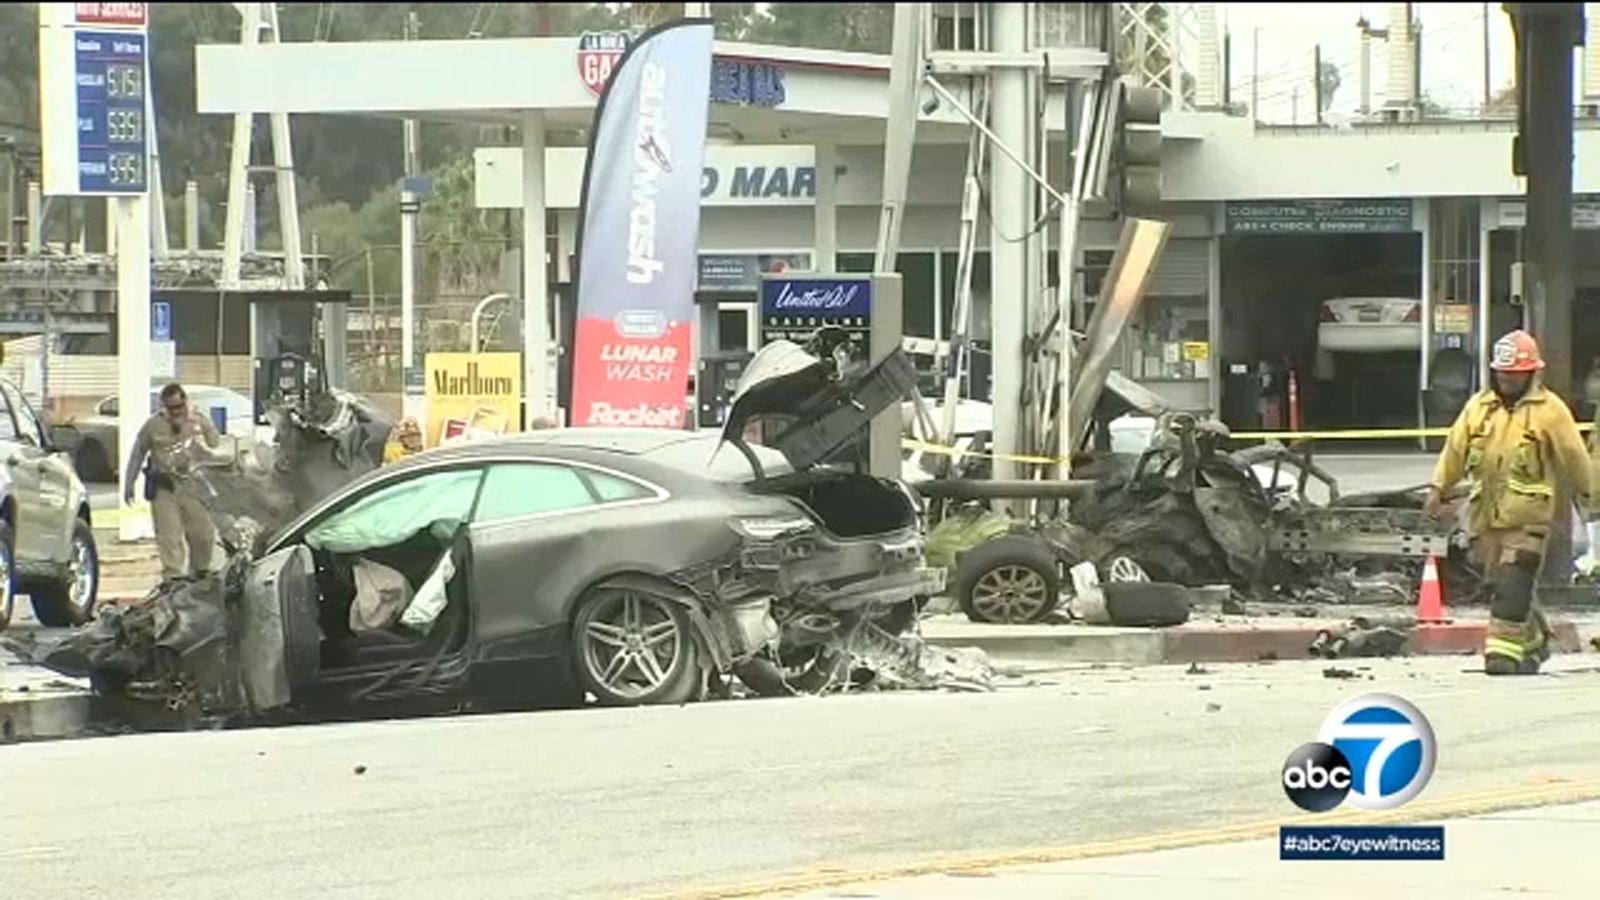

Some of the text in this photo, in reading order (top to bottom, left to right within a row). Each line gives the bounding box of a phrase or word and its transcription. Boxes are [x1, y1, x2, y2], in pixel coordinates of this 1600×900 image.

[730, 166, 847, 198] MAR
[1270, 222, 1314, 231] CHECK
[601, 344, 677, 362] LUNAR
[434, 362, 513, 396] Marlboro
[607, 364, 673, 382] WASH
[586, 401, 682, 426] Rocket
